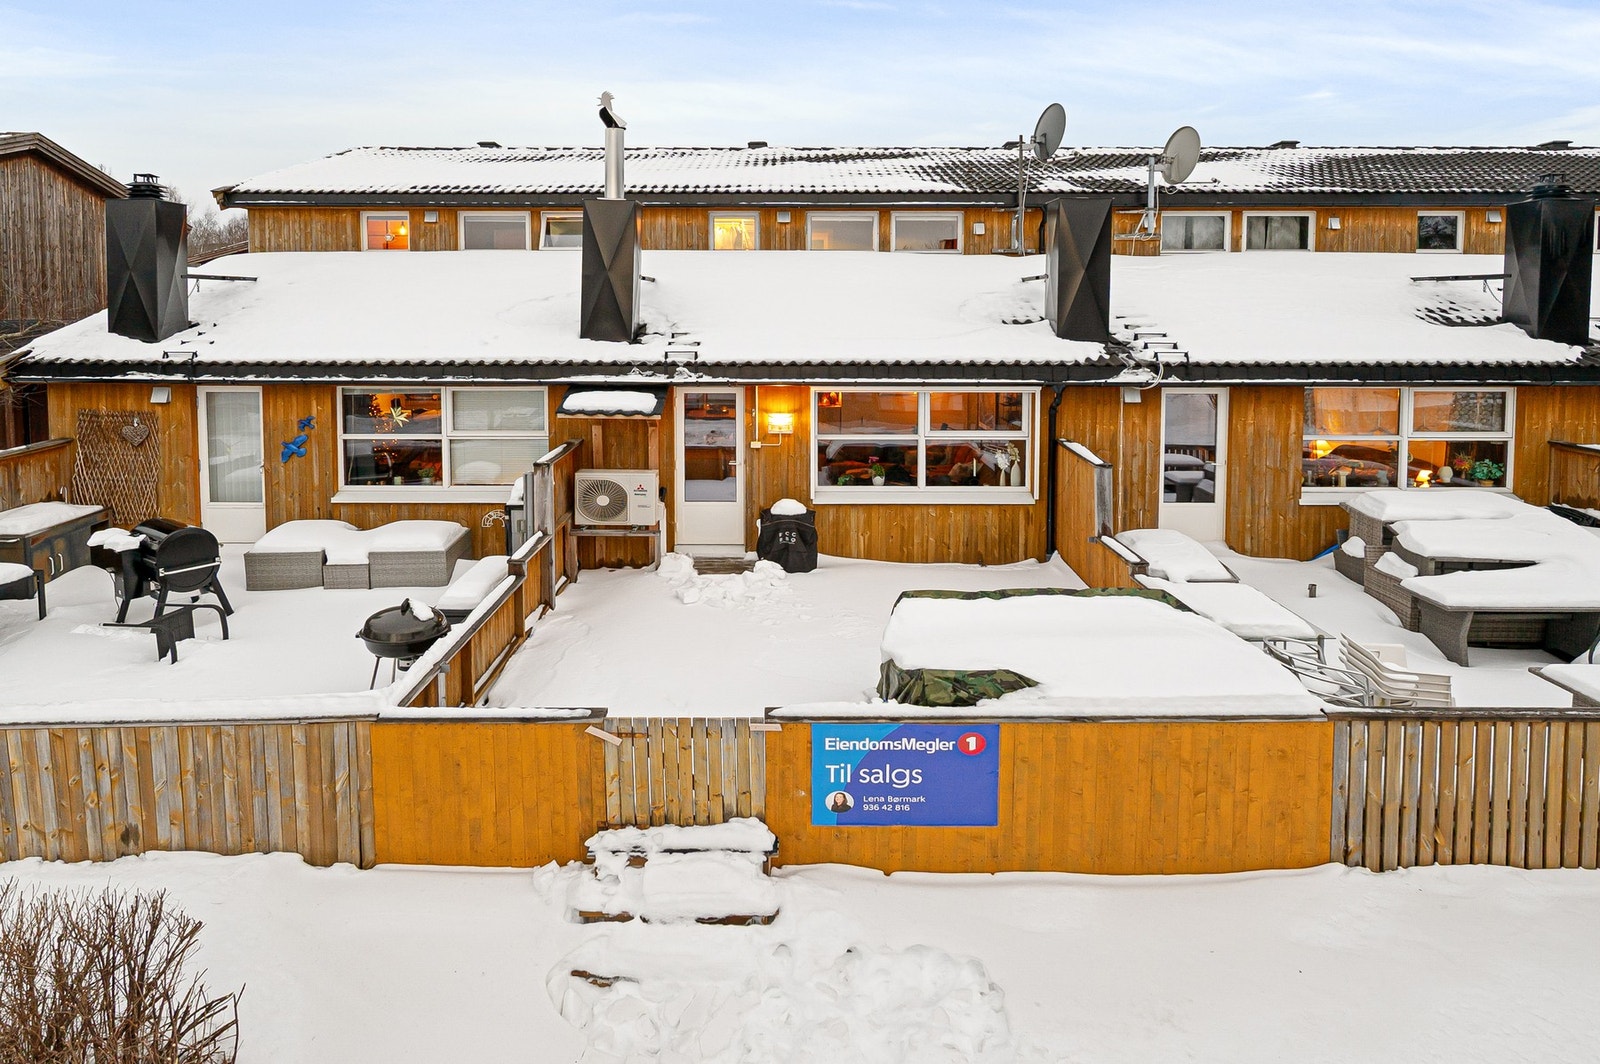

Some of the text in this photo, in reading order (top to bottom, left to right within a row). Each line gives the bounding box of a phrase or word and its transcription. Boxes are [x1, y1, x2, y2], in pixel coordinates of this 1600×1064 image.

[824, 736, 977, 754] EiendomsMegler 1
[825, 763, 923, 788] Til salgs
[863, 795, 926, 803] Lena Børmark
